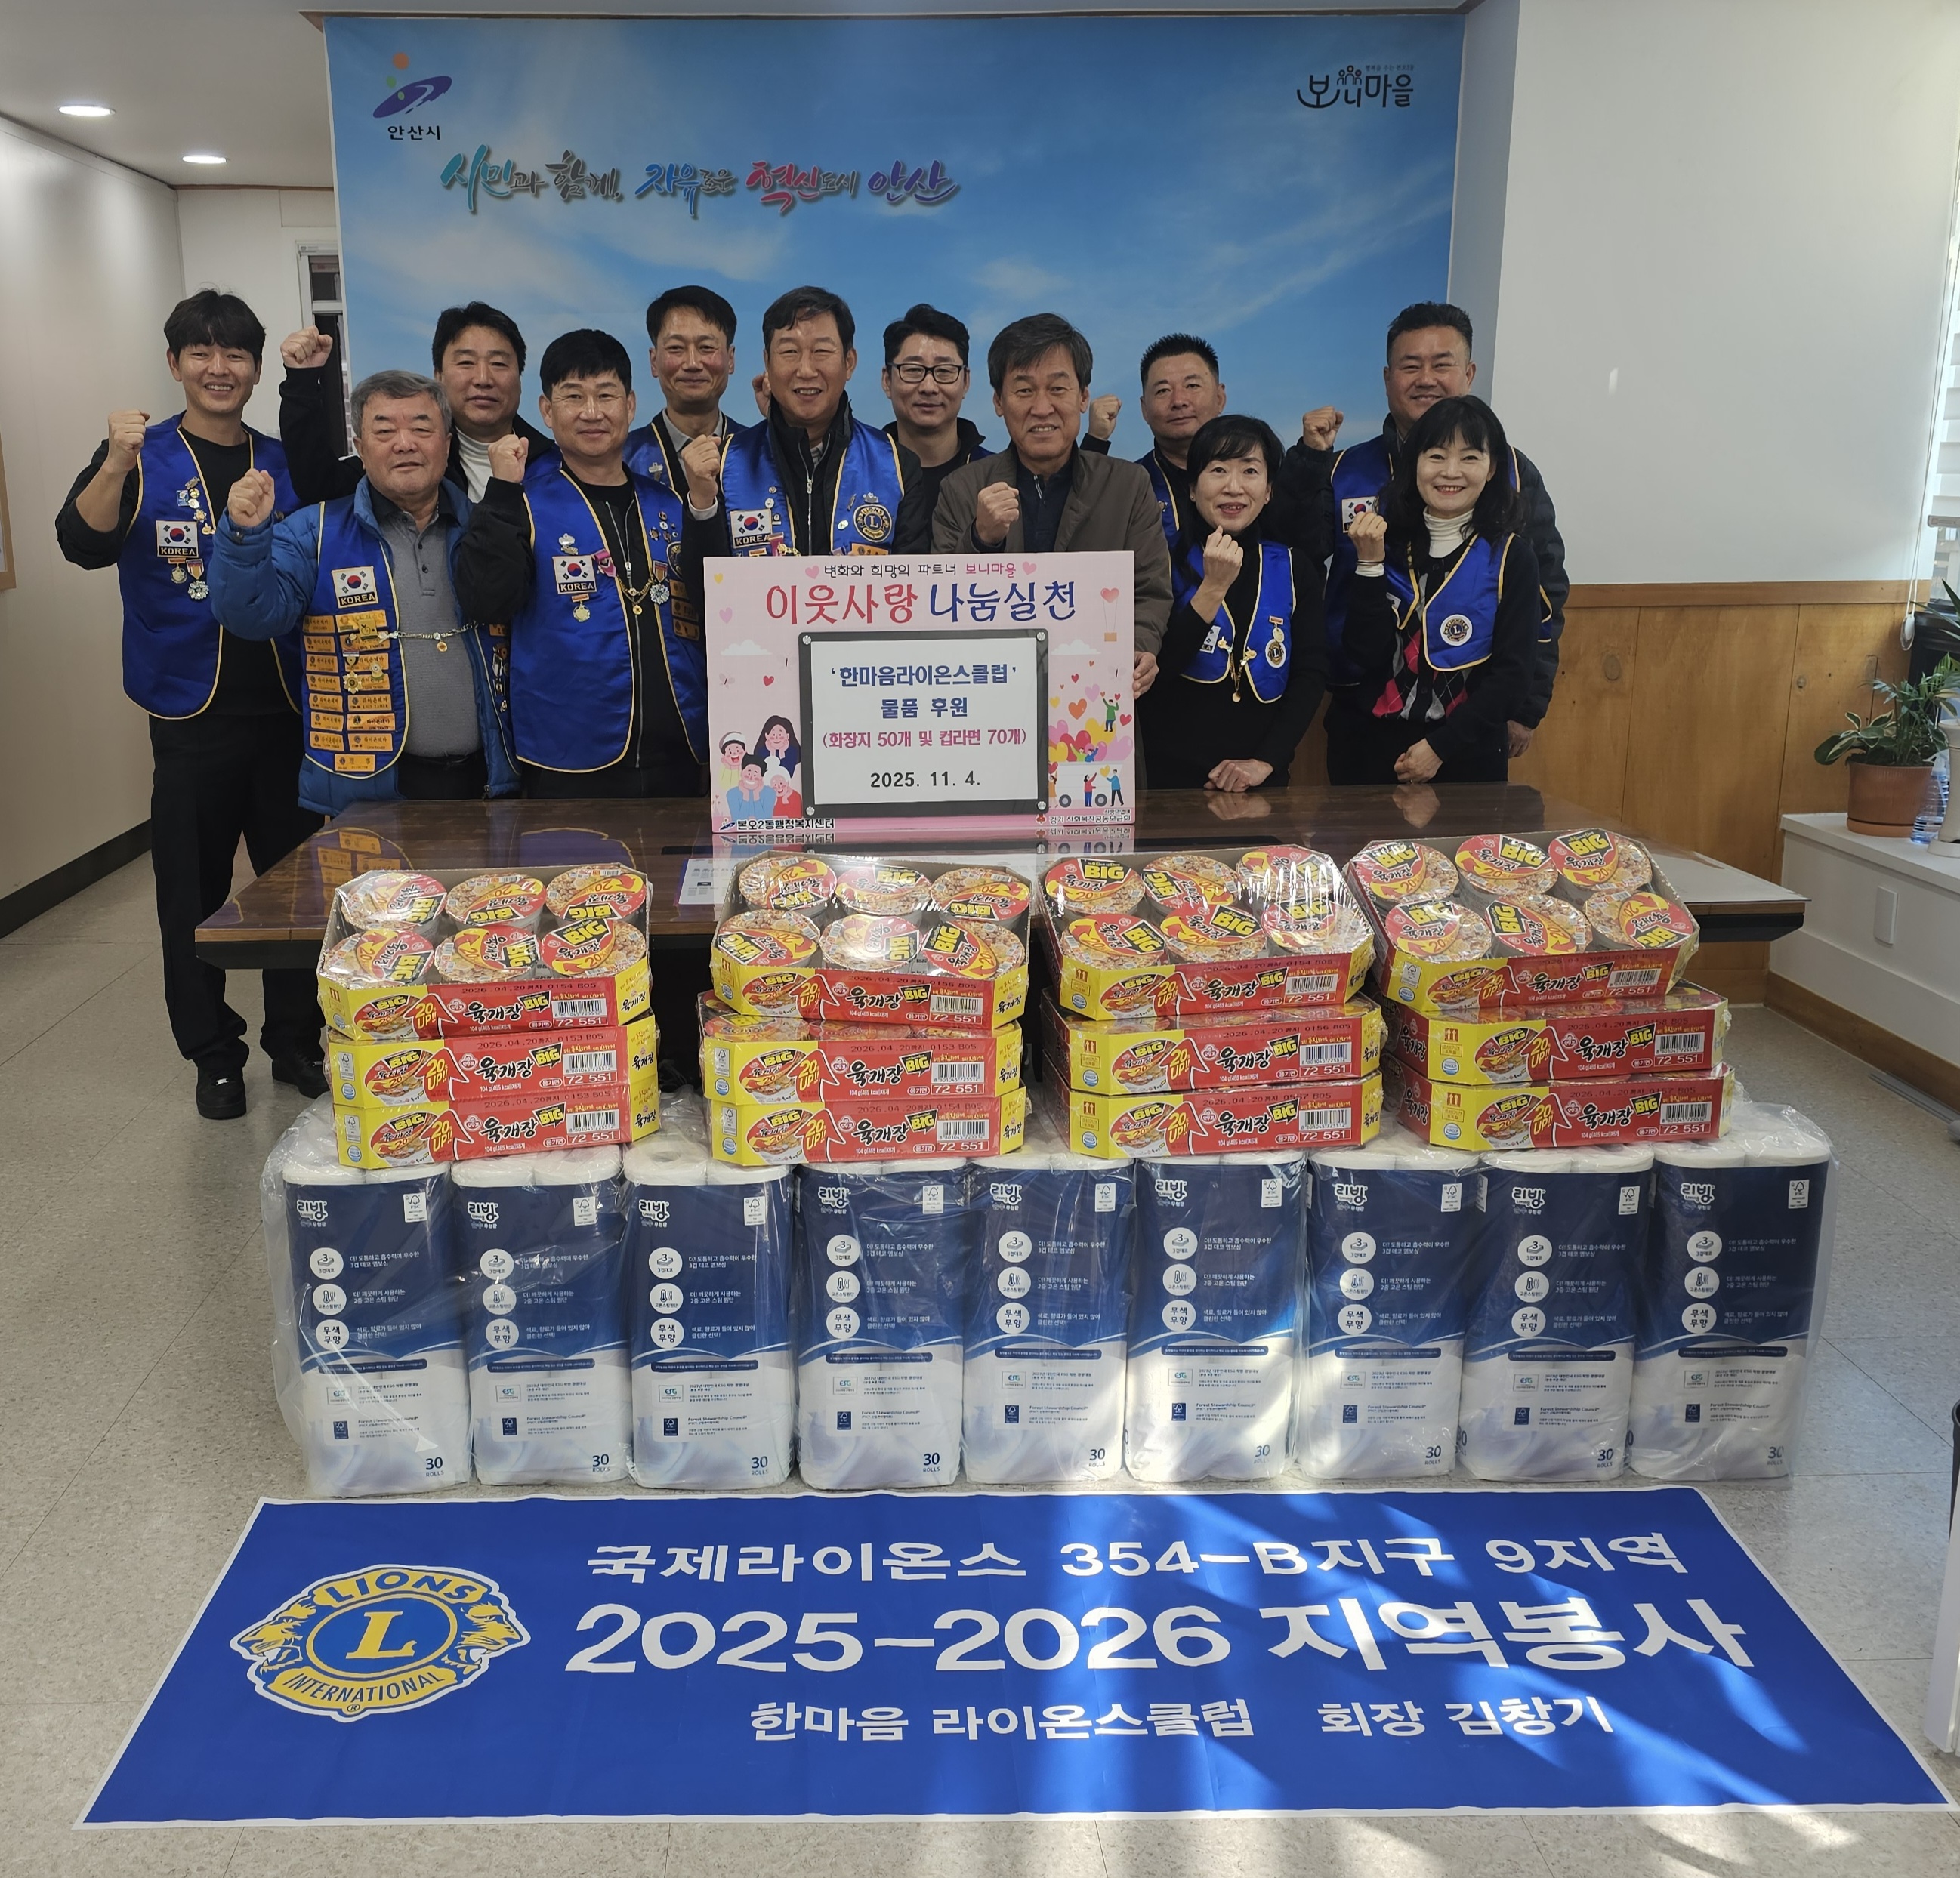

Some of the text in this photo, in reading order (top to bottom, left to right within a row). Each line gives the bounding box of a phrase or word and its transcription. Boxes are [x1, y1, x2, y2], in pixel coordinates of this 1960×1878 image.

[388, 126, 440, 140] 안산시
[440, 144, 955, 216] 시민과 함께, 자유로운 혁신도시 안산
[869, 516, 878, 527] L
[736, 535, 770, 544] KOREA
[824, 563, 1017, 578] 변화와 희망의 파트너 보니마을
[340, 594, 375, 605] KOREA
[766, 581, 1076, 624] 이웃사랑 나눔실천
[881, 698, 968, 718] 물품 후원
[823, 729, 1026, 748] (화장지 50개 및 컵라면 70개)
[870, 770, 980, 788] 2025. 11. 4.
[738, 819, 834, 829] 본오2동행정복지센터
[1568, 834, 1609, 856] BIG
[1375, 846, 1415, 867] BIG
[1502, 844, 1542, 866] BIG
[1565, 854, 1606, 868] 육개장
[1085, 865, 1124, 879] BIG
[1372, 866, 1412, 881] 육개장
[1061, 874, 1104, 891] 육개장
[1261, 972, 1284, 985] BIG
[1587, 967, 1609, 979] BIG
[1529, 973, 1582, 991] 육개장
[904, 987, 928, 1001] BIG
[1203, 979, 1258, 1001] 육개장
[1307, 993, 1331, 1001] 551
[524, 996, 548, 1009] BIG
[847, 988, 901, 1010] 육개장
[465, 1001, 521, 1021] 육개장
[557, 1017, 603, 1026] 72 551
[954, 1015, 978, 1023] 551
[1630, 1031, 1653, 1045] BIG
[1273, 1040, 1298, 1055] BIG
[1575, 1038, 1628, 1060] 육개장
[536, 1049, 560, 1066] BIG
[906, 1057, 929, 1072] BIG
[1216, 1048, 1272, 1072] 육개장
[1677, 1056, 1698, 1064] 551
[475, 1056, 534, 1080] 육개장
[847, 1064, 904, 1087] 육개장
[1304, 1065, 1347, 1075] 72 551
[427, 1070, 448, 1090] UP!!
[566, 1072, 613, 1084] 72 551
[934, 1084, 980, 1093] 72 551
[1273, 1106, 1296, 1121] BIG
[1636, 1099, 1659, 1113] BIG
[539, 1109, 563, 1125] BIG
[911, 1115, 935, 1130] BIG
[1579, 1104, 1632, 1129] 육개장
[480, 1118, 536, 1141] 육개장
[1215, 1115, 1269, 1136] 육개장
[1663, 1124, 1705, 1134] 72 551
[570, 1130, 616, 1142] 72 551
[852, 1121, 907, 1146] 육개장
[1302, 1131, 1347, 1141] 72 551
[940, 1141, 985, 1151] 72 551
[819, 1188, 849, 1207] 리빙
[991, 1184, 1021, 1204] 리빙
[1156, 1180, 1187, 1200] 리빙
[1335, 1185, 1367, 1204] 리빙
[1513, 1188, 1545, 1207] 리빙
[1681, 1184, 1714, 1204] 리빙
[298, 1201, 327, 1220] 리빙
[468, 1203, 498, 1222] 리빙
[640, 1201, 669, 1220] 리빙
[1520, 1313, 1538, 1321] 무색
[1520, 1323, 1537, 1331] 무향
[659, 1334, 675, 1343] 무향
[1089, 1448, 1105, 1460] 30
[1255, 1445, 1270, 1457] 30
[1425, 1446, 1441, 1458] 30
[1597, 1448, 1613, 1461] 30
[425, 1457, 443, 1470] 30
[592, 1454, 610, 1466] 30
[752, 1456, 767, 1469] 30
[923, 1453, 940, 1465] 30
[588, 1532, 1688, 1584] 국제라이온스 354-B지구 9지역
[325, 1572, 479, 1603] LIONS
[346, 1611, 417, 1658] L
[565, 1597, 1754, 1672] 2025-2026 지역봉사
[283, 1670, 444, 1702] INTERNATIONAL
[751, 1696, 1613, 1741] 한마음 라이온스클럽 회장 김창기
